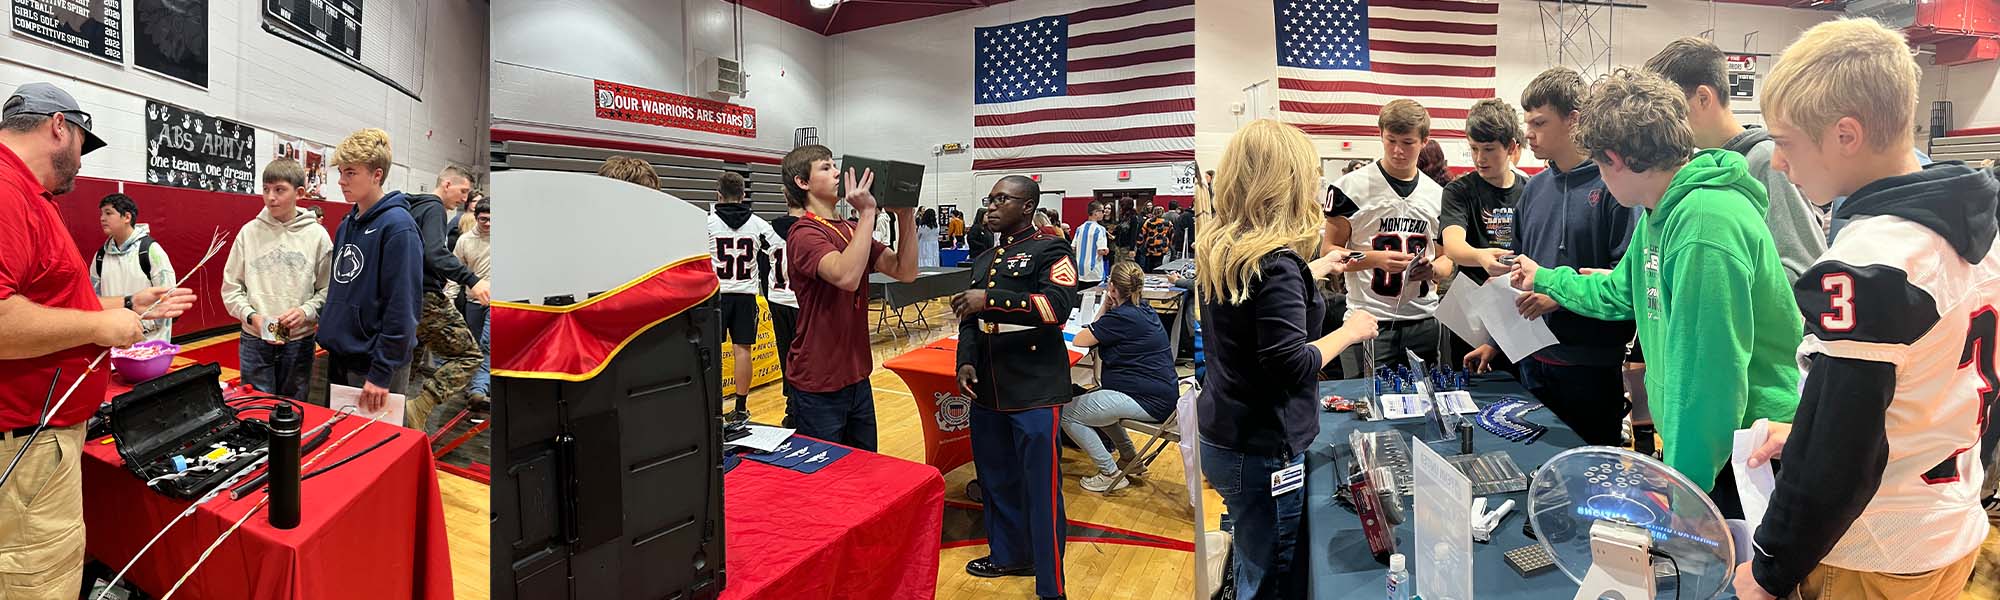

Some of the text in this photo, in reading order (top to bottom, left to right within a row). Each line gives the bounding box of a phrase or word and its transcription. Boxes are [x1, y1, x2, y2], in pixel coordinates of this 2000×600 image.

[14, 5, 121, 49] GIRLS GOLF 2022
[66, 2, 91, 18] SPIRIT
[104, 17, 119, 30] 2021
[14, 17, 121, 59] COMPETITIVE SPIRIT 2022
[104, 27, 120, 40] 2021
[615, 95, 743, 127] OUR WARRIORS ARE STARS
[201, 133, 245, 160] ARMY
[150, 155, 170, 168] one
[205, 164, 222, 176] one
[223, 166, 253, 181] dream
[1379, 217, 1428, 233] MONITEAU
[715, 237, 755, 281] 52
[1820, 271, 1857, 333] 3
